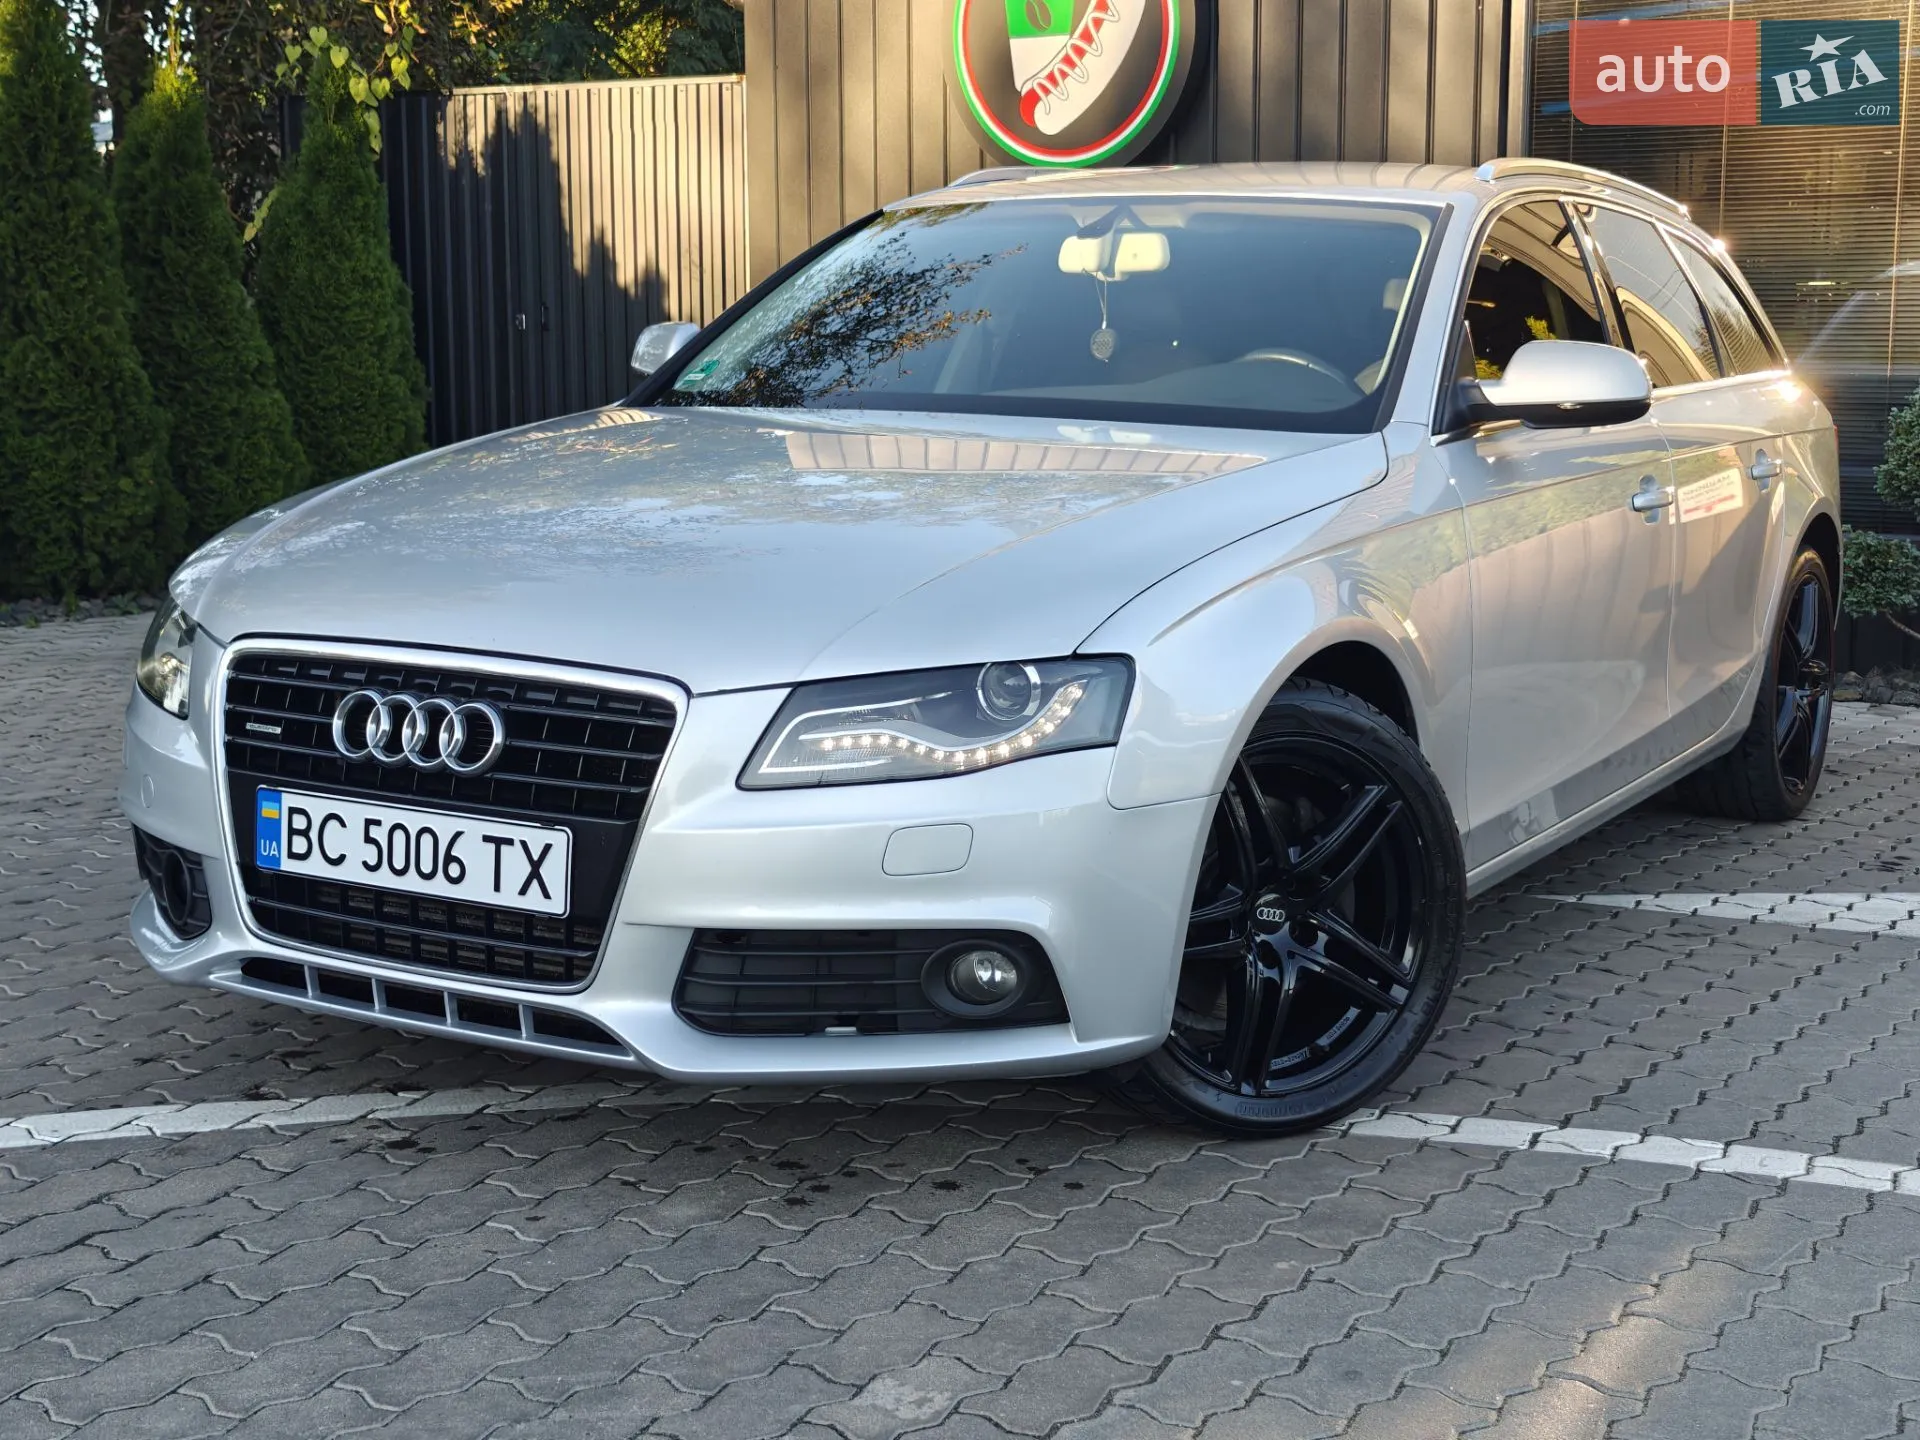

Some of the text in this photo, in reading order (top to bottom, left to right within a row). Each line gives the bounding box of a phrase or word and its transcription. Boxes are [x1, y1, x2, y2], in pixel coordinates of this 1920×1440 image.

[260, 839, 279, 858] UA
[286, 806, 553, 900] BC 5006 TX
